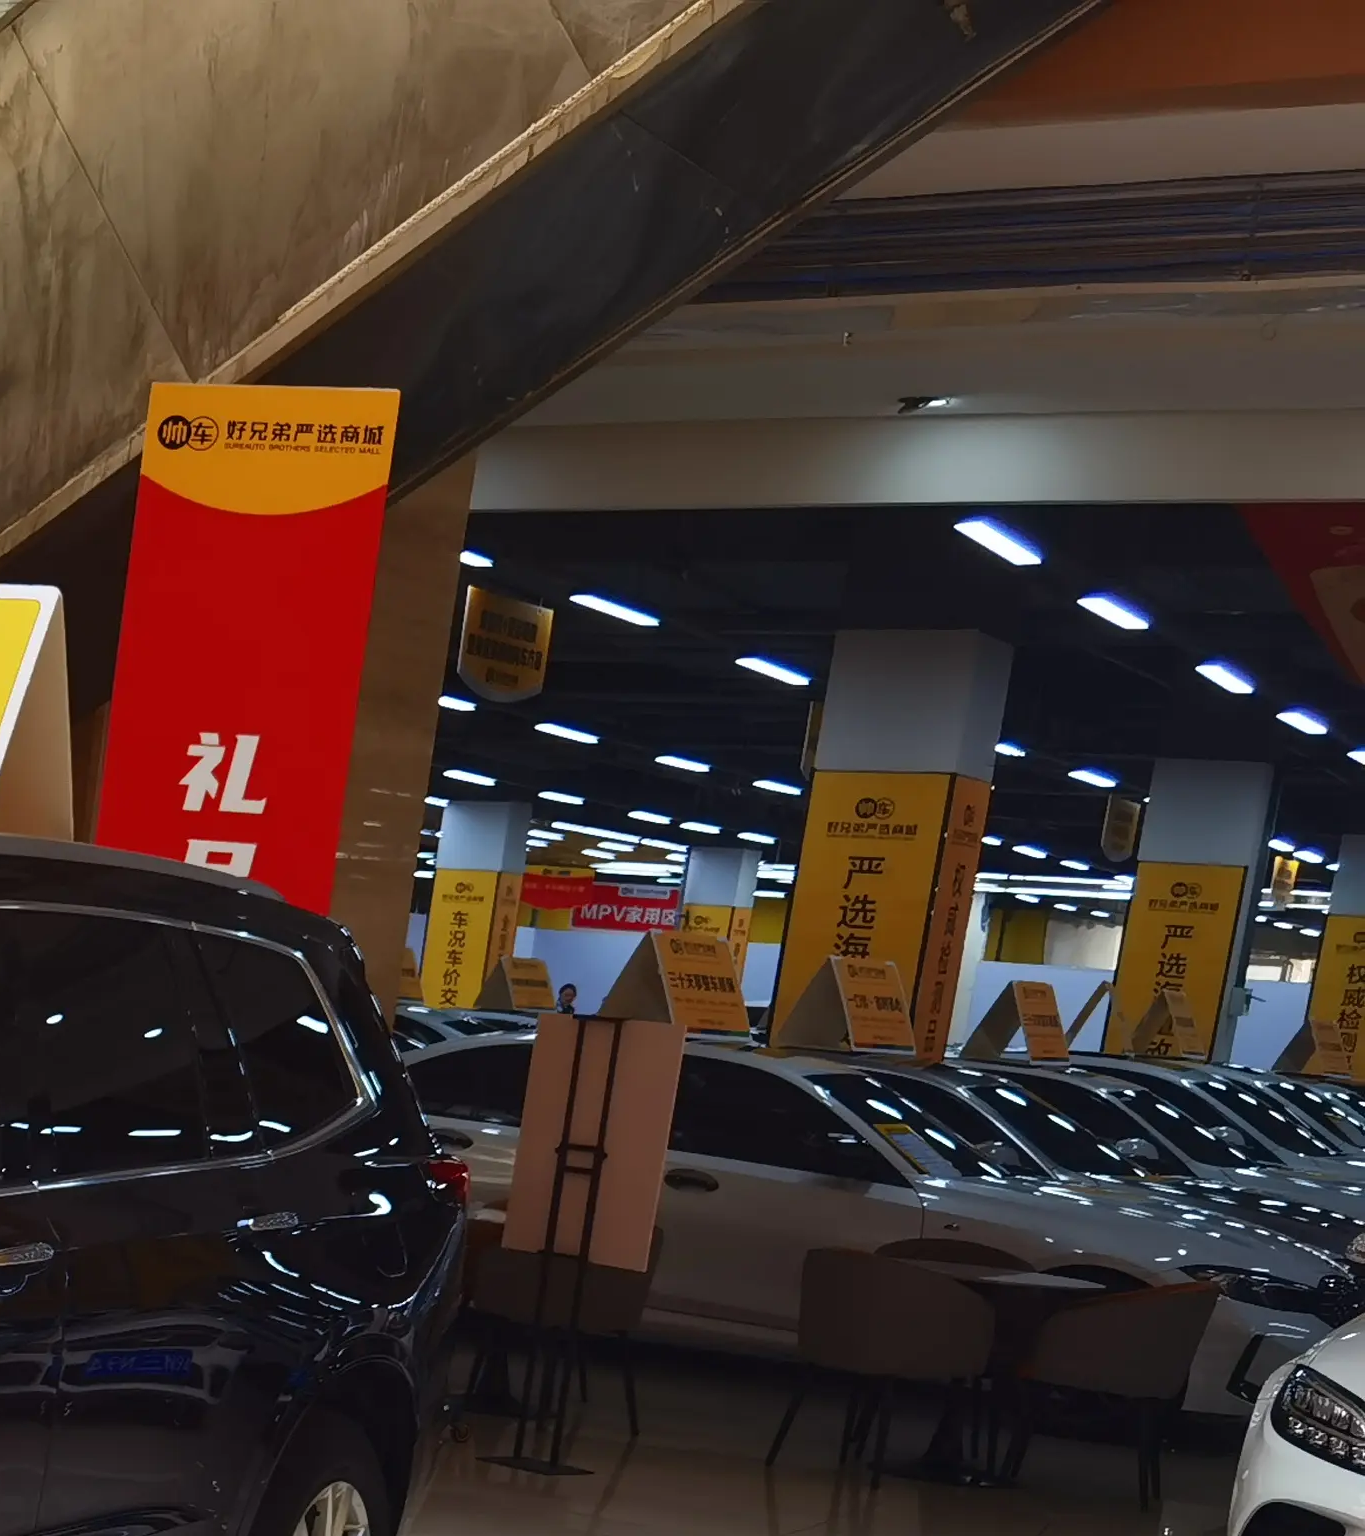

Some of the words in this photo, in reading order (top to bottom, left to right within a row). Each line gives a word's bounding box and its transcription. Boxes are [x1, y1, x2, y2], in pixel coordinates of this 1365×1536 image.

[160, 418, 216, 448] 帅车
[225, 420, 385, 446] 好兄弟严选商城
